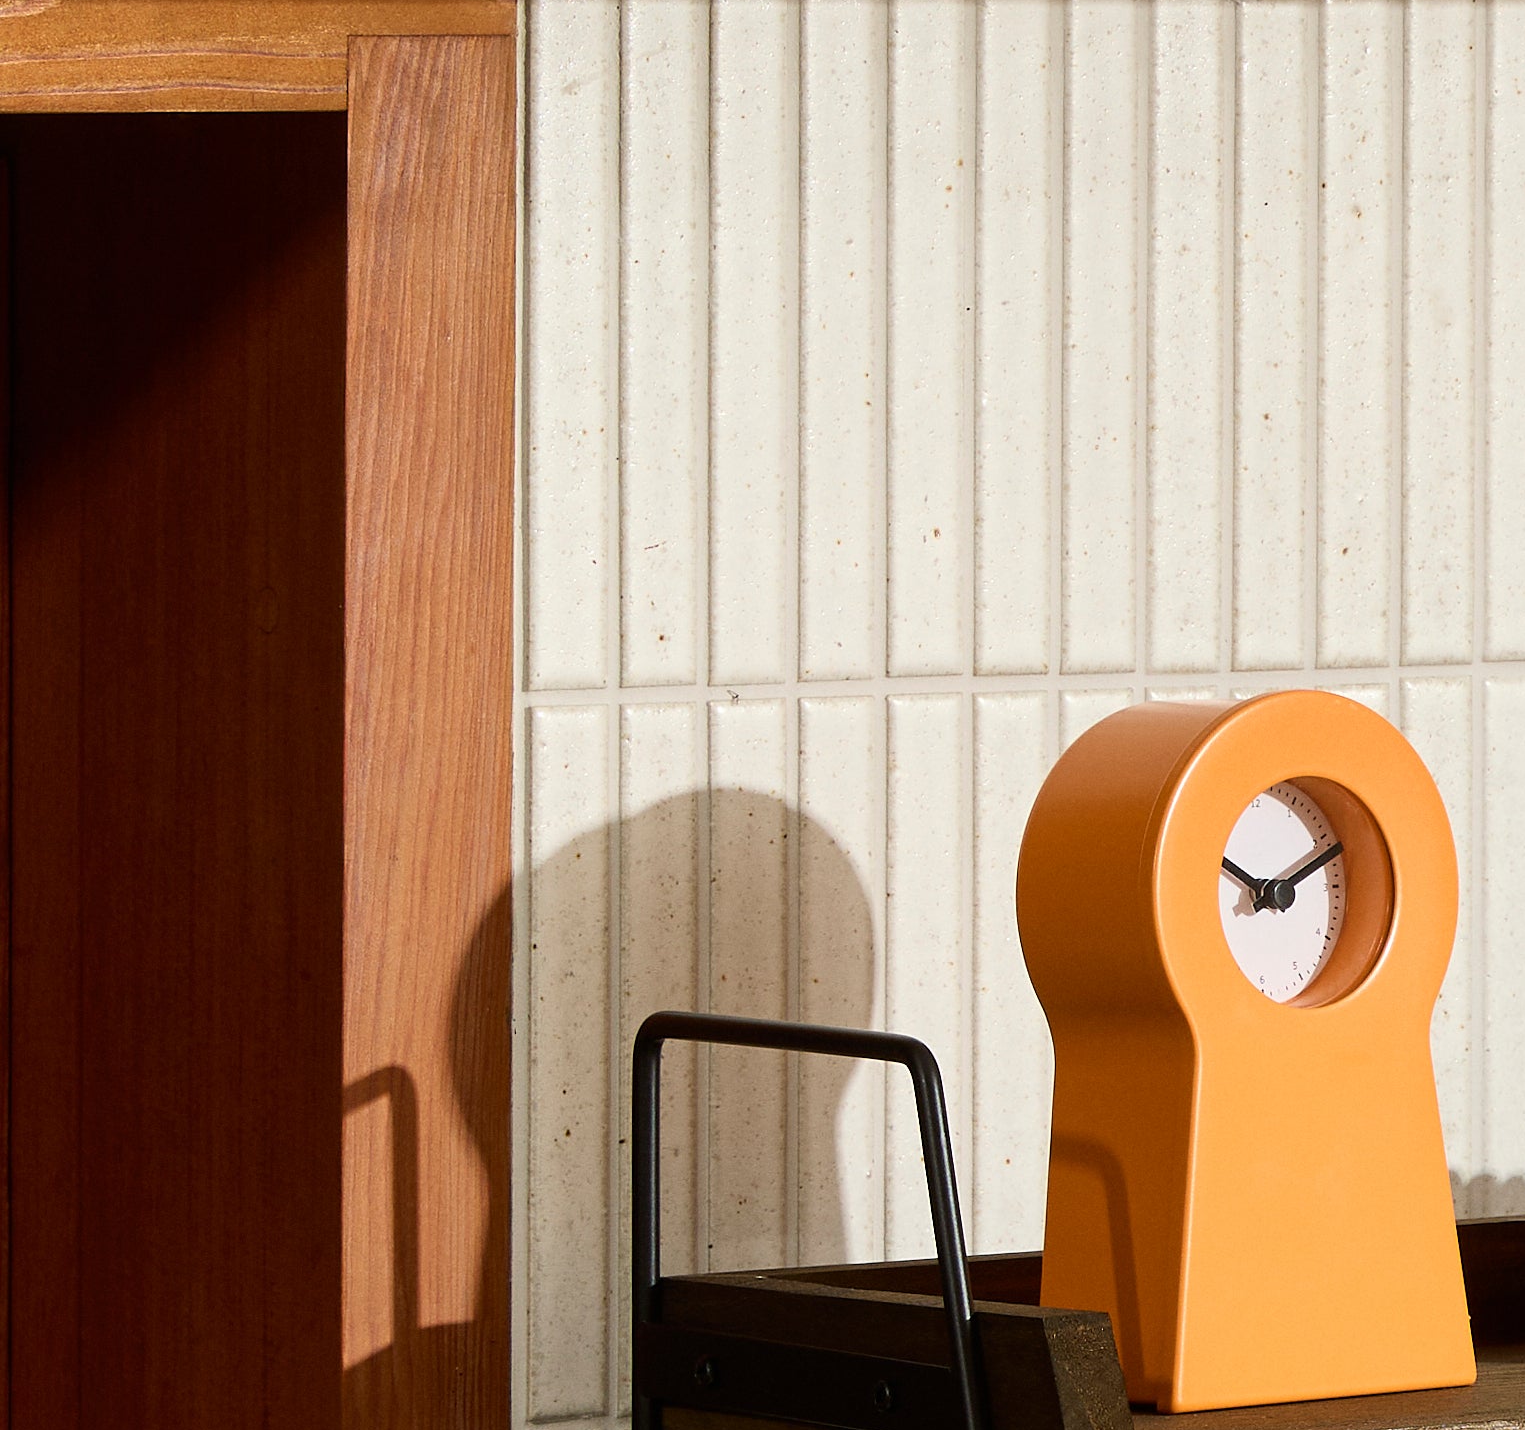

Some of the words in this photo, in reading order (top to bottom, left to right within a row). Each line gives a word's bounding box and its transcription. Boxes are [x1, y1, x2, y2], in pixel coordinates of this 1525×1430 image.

[1250, 799, 1261, 808] 12
[1323, 883, 1328, 892] 3
[1315, 927, 1321, 936] 4
[1292, 961, 1297, 970] 5
[1259, 976, 1265, 985] 6
